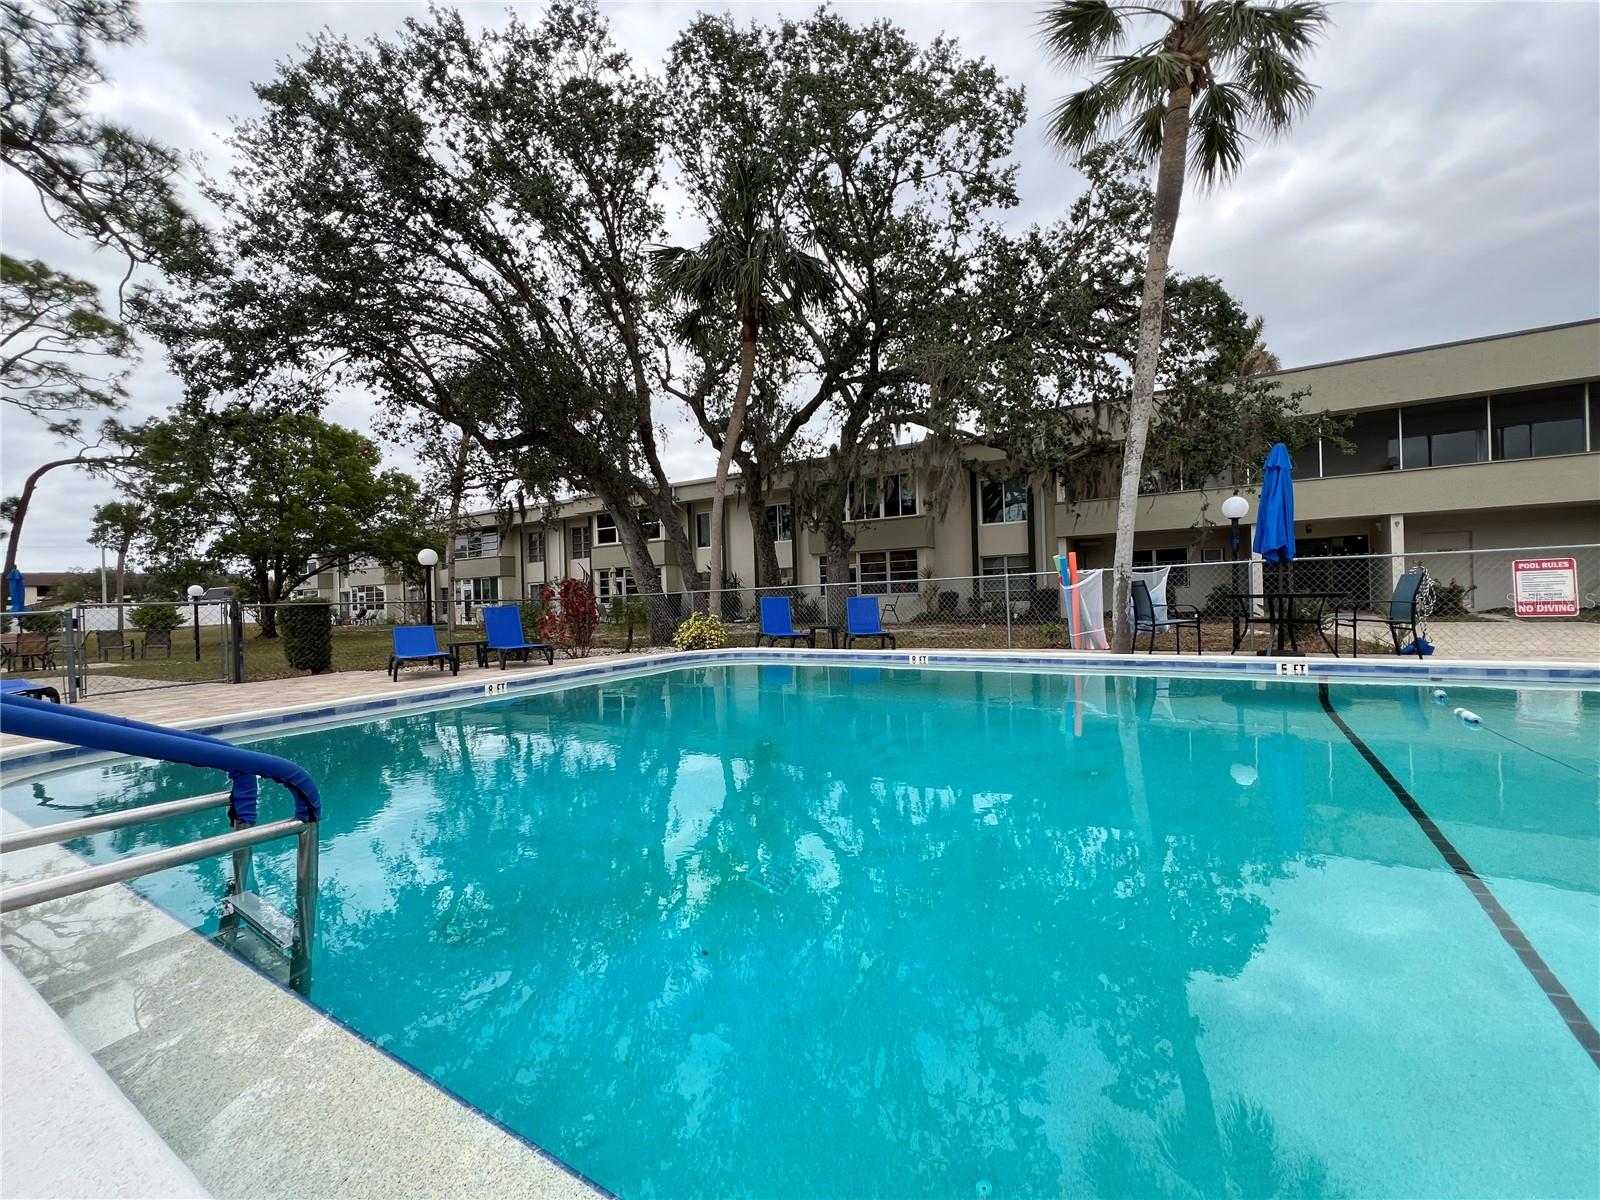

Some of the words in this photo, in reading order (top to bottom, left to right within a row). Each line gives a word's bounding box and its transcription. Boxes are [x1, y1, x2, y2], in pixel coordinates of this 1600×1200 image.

[1518, 604, 1534, 612] NO
[1536, 604, 1575, 612] DIVING
[1293, 663, 1306, 673] FT
